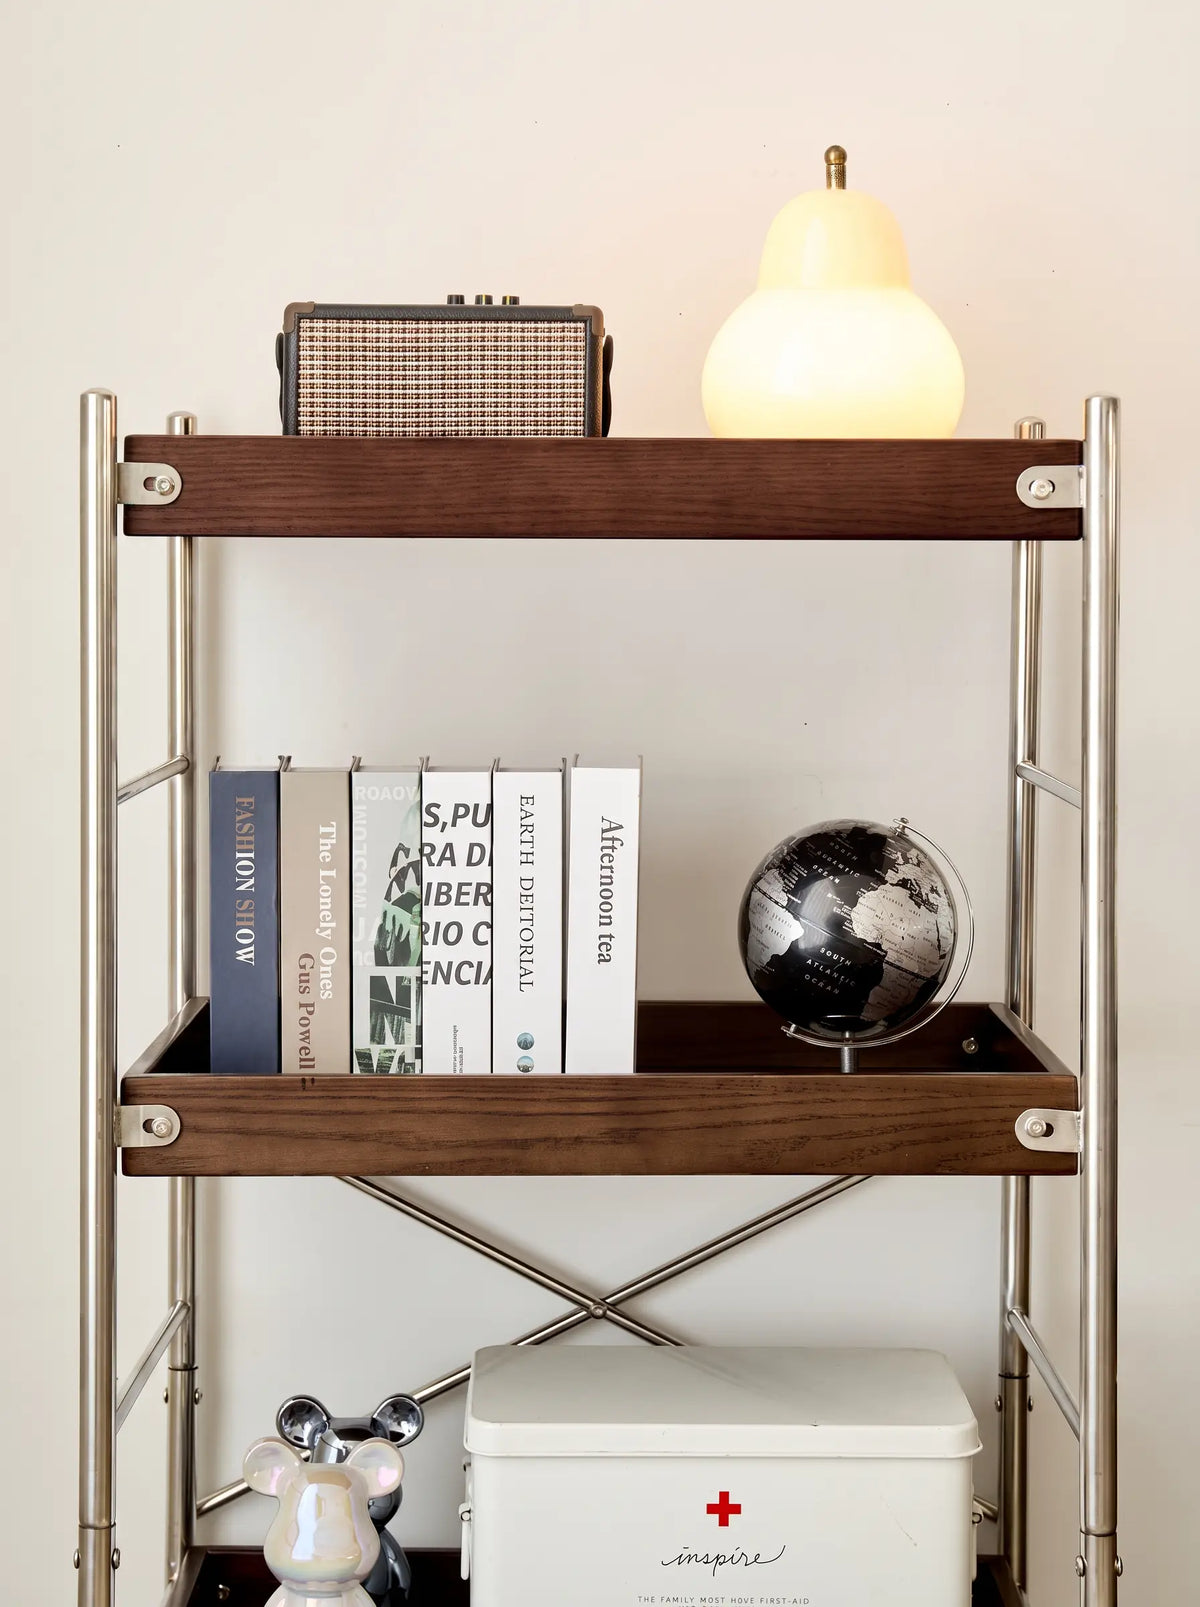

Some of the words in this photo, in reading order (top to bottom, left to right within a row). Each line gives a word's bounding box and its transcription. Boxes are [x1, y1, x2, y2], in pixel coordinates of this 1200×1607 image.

[235, 796, 255, 892] FASHION
[319, 821, 337, 862] The
[423, 802, 492, 832] S,PU
[519, 794, 535, 867] EARTH
[421, 842, 457, 867] RA
[465, 842, 492, 867] D
[598, 815, 625, 928] Afternoon
[316, 868, 337, 940] Lonely
[235, 899, 255, 966] SHOW
[519, 876, 535, 993] DEITORIAL
[597, 932, 616, 966] tea
[298, 953, 316, 994] Gus
[319, 946, 337, 1000] Ones
[298, 1001, 316, 1070] Powell
[661, 1545, 786, 1577] inspire
[660, 1596, 695, 1604] FAMILY
[699, 1596, 725, 1604] MOST
